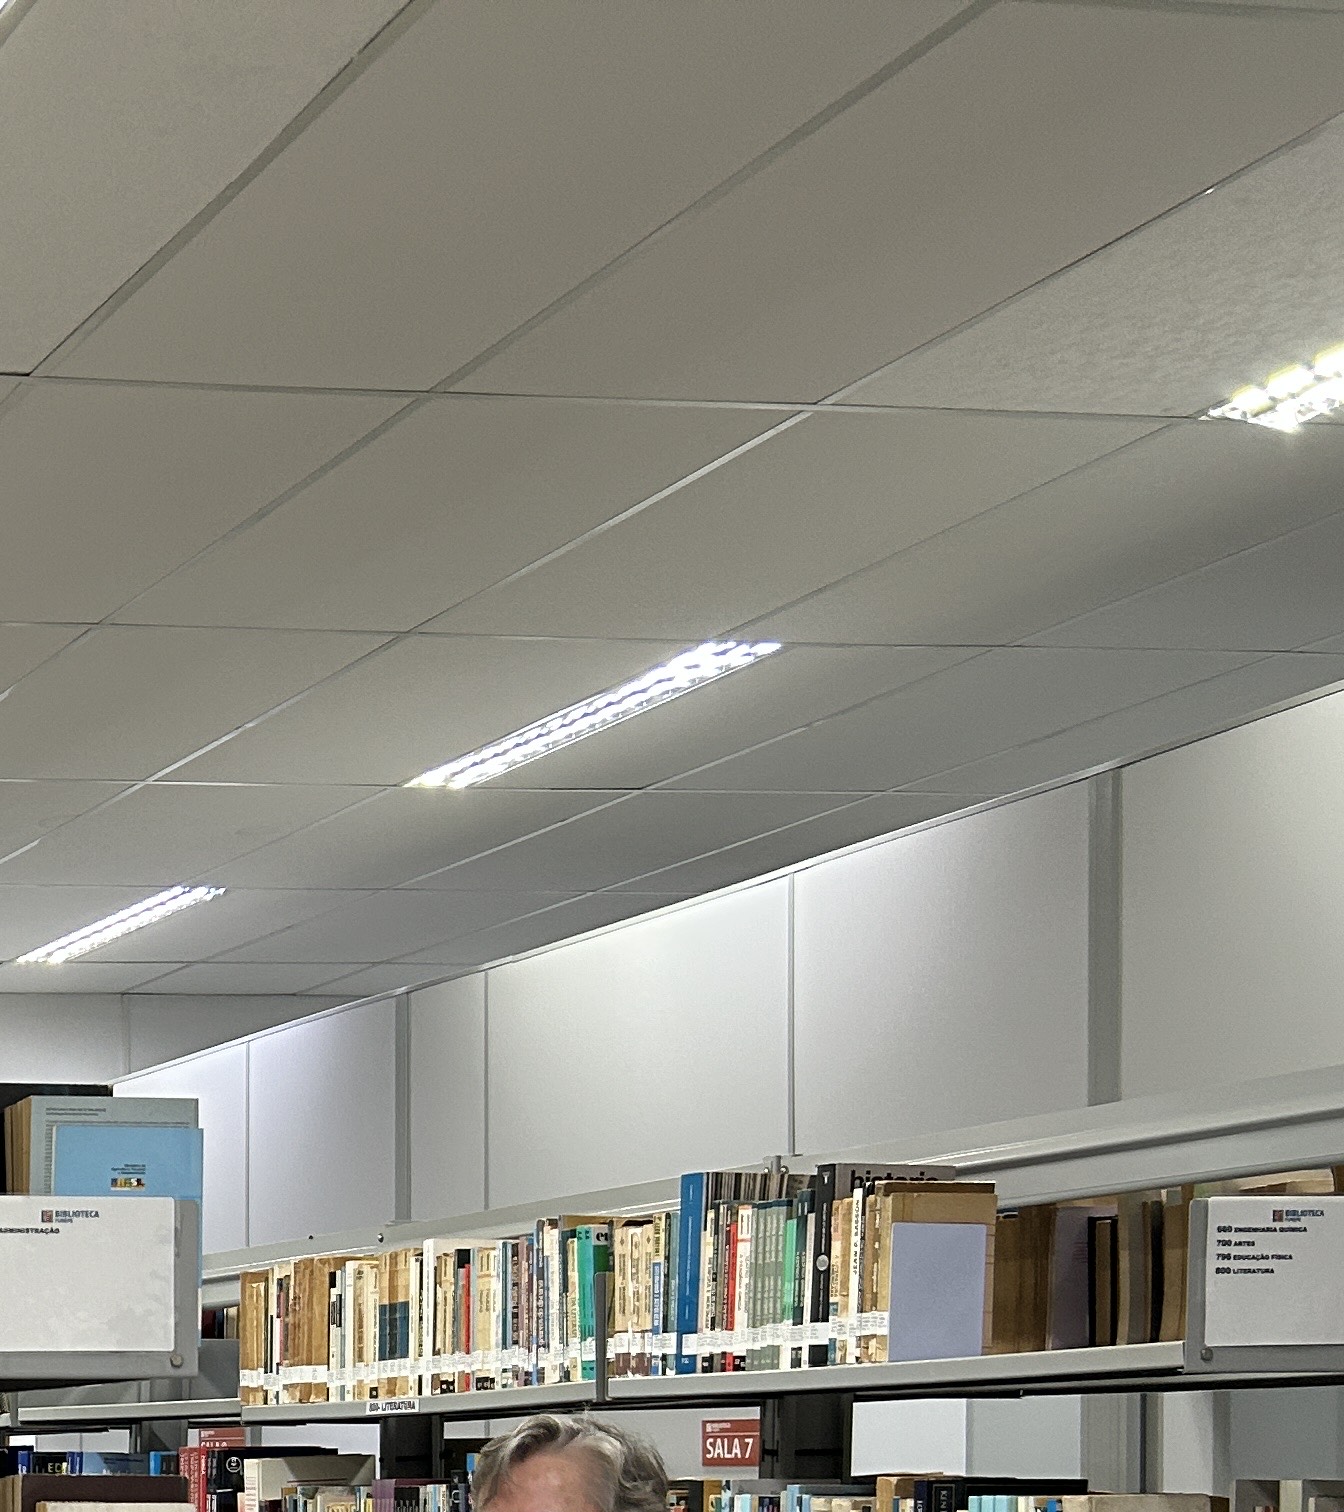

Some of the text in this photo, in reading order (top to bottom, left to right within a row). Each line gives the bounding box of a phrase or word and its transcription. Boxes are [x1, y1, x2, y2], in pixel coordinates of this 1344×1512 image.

[55, 1210, 100, 1219] BIBLIOTECA
[1285, 1209, 1325, 1217] BIBLIOTECA
[706, 1438, 754, 1458] SALA 7
[940, 1490, 949, 1509] KEN
